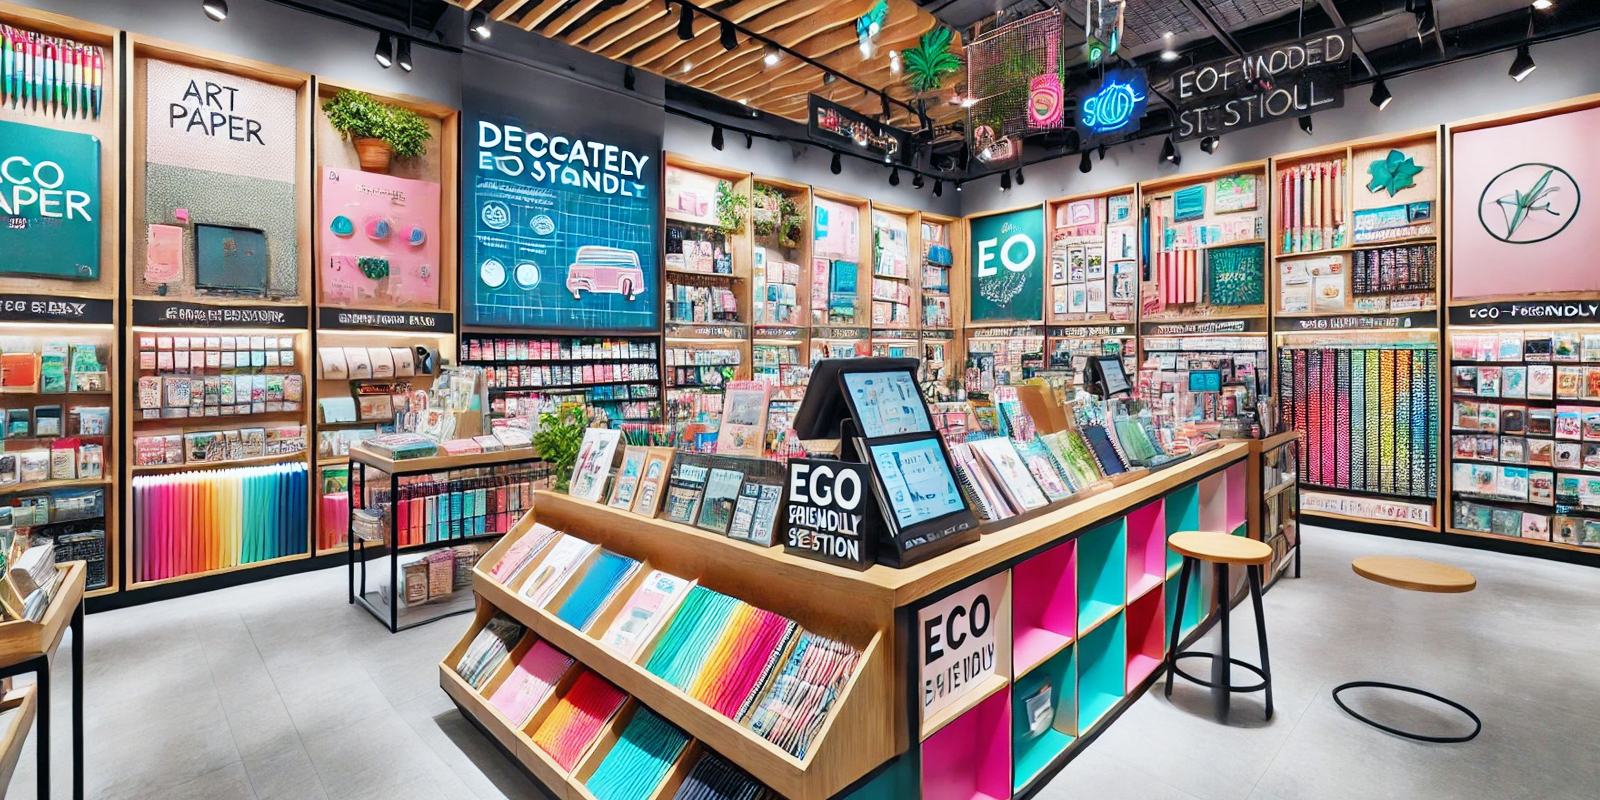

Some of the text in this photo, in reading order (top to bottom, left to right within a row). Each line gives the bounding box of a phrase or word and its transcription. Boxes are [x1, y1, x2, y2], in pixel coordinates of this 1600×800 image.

[182, 79, 239, 111] ART
[170, 103, 265, 146] PAPER
[0, 155, 64, 189] CO
[978, 233, 1036, 277] EO
[789, 463, 862, 510] EGO
[924, 594, 991, 666] ECO
